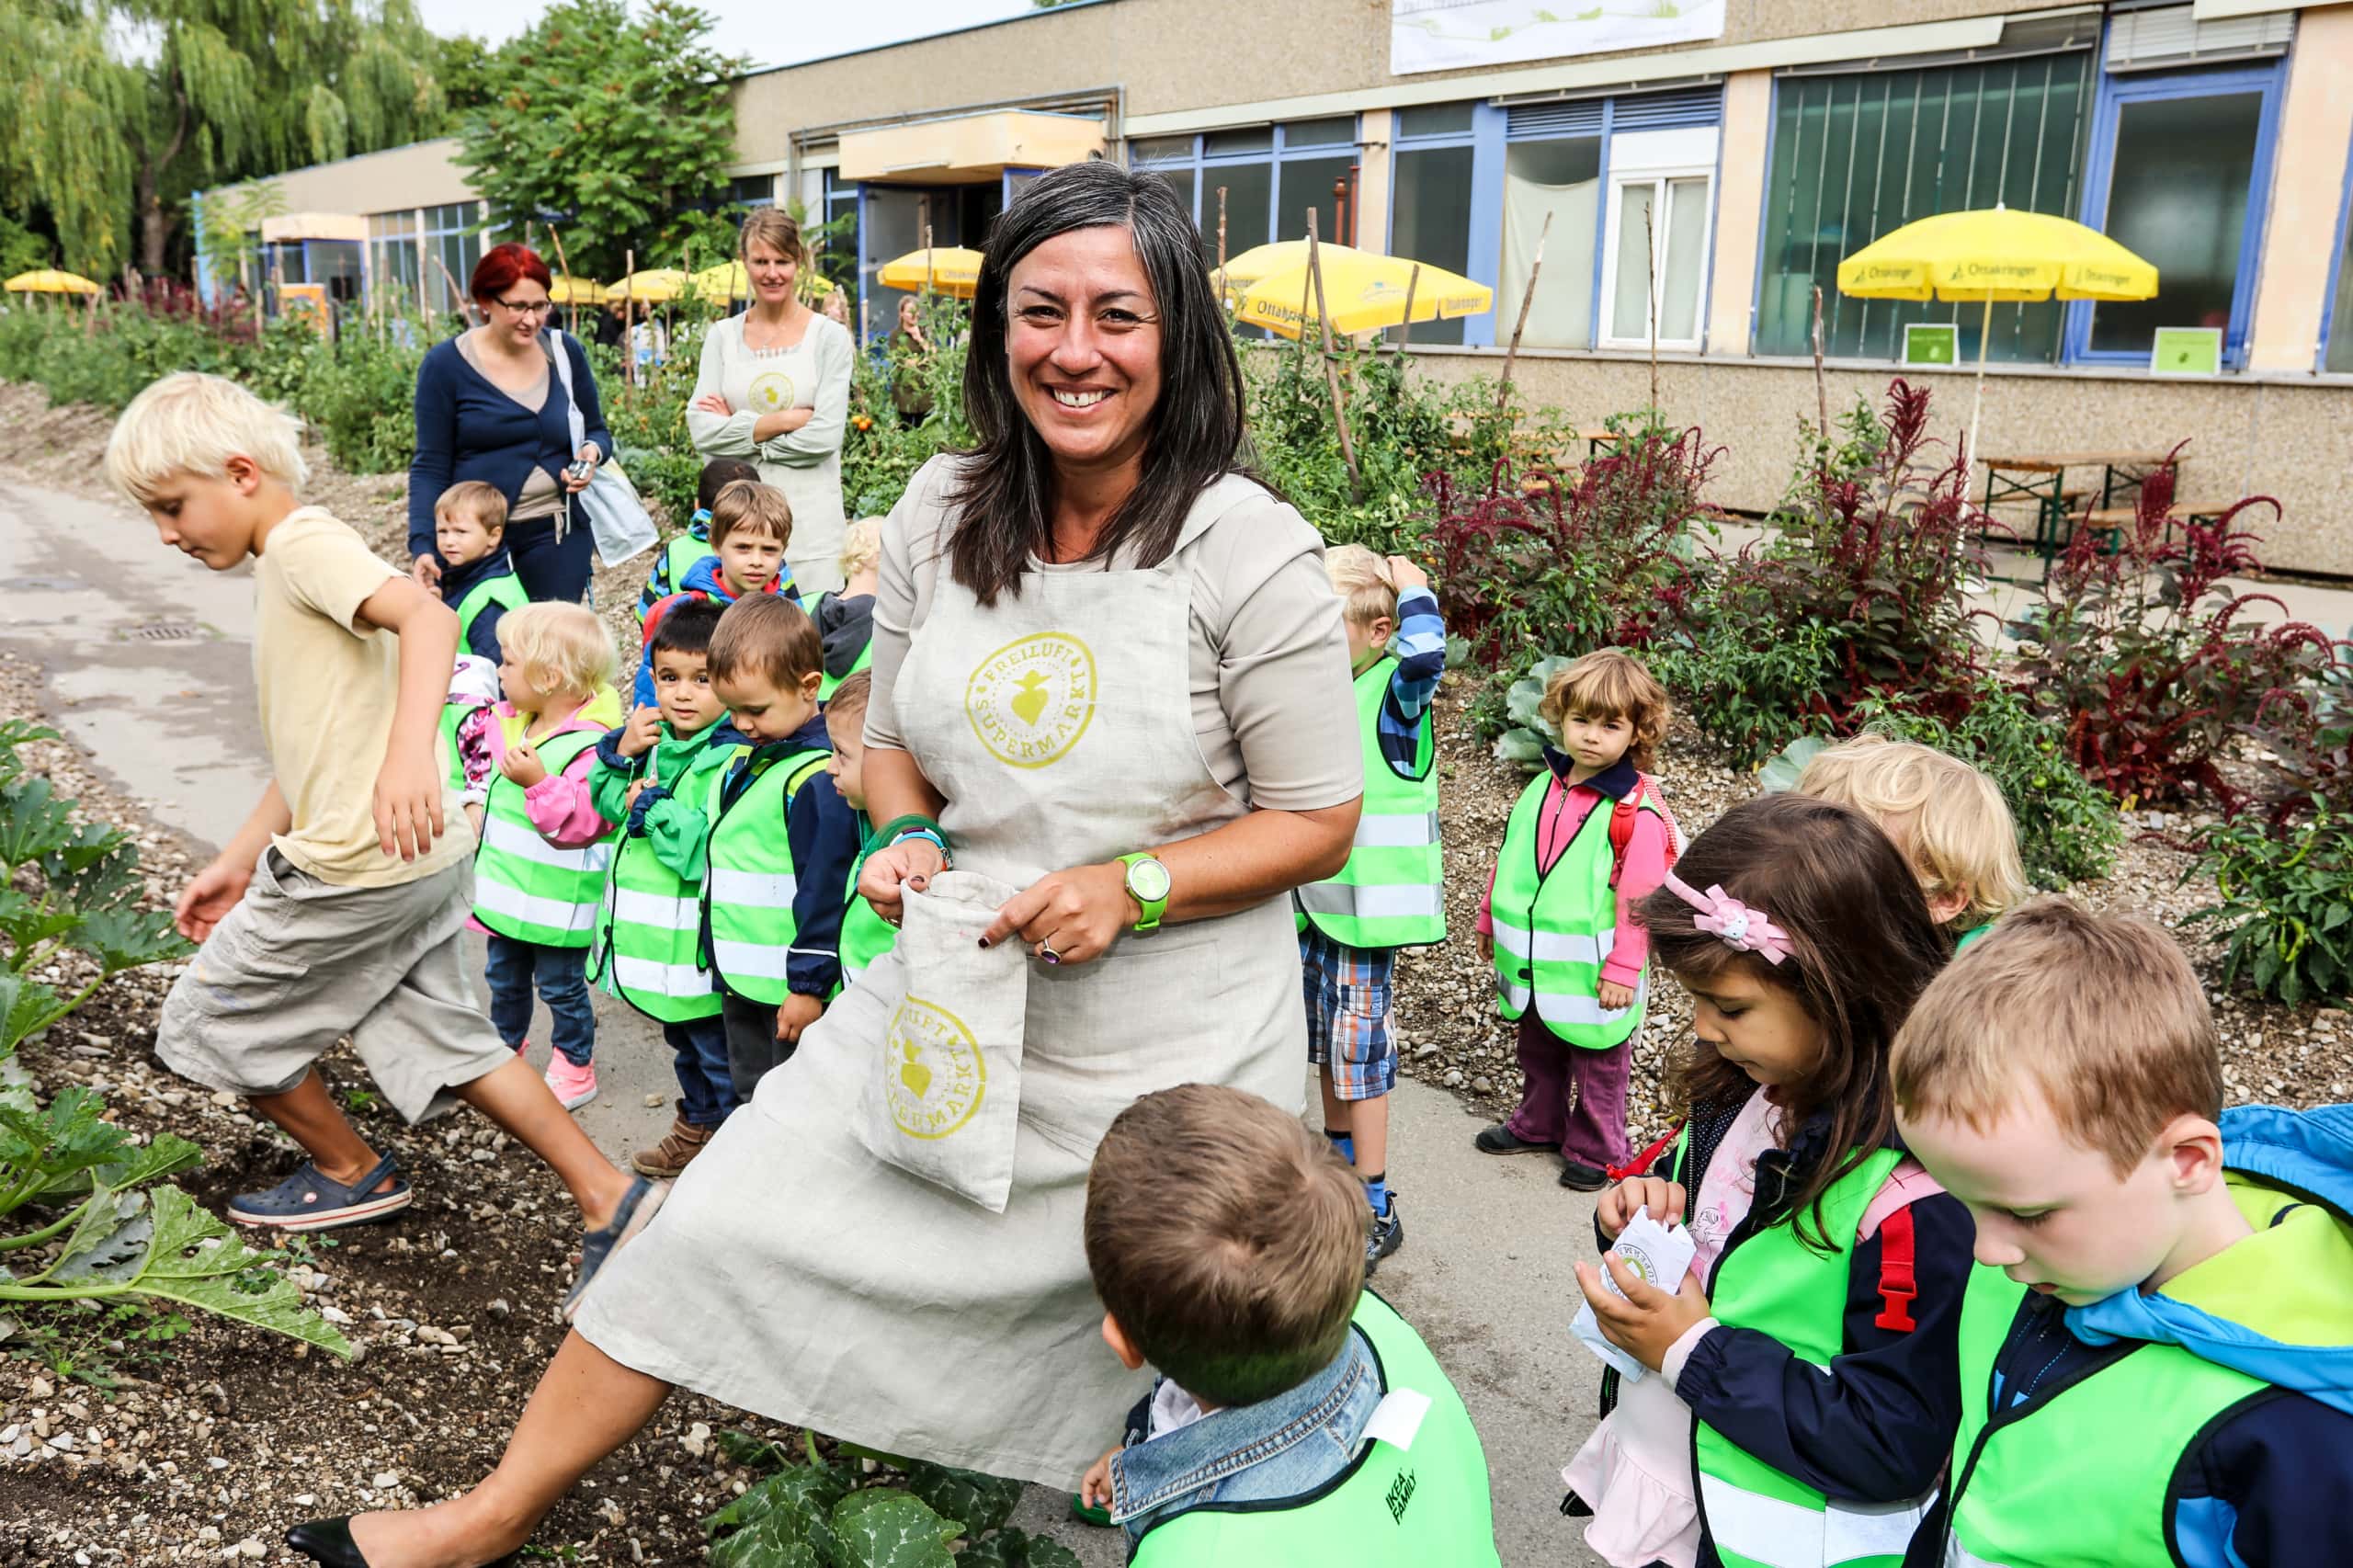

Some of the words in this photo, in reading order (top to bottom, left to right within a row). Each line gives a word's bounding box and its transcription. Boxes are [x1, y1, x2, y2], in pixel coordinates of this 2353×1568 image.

[1969, 263, 2037, 278] Ottakringer
[983, 642, 1074, 682] FREILUFT
[975, 670, 1086, 758] SUPERMARKT
[1385, 1471, 1406, 1510] IKEA
[1392, 1469, 1417, 1526] FAMILY
